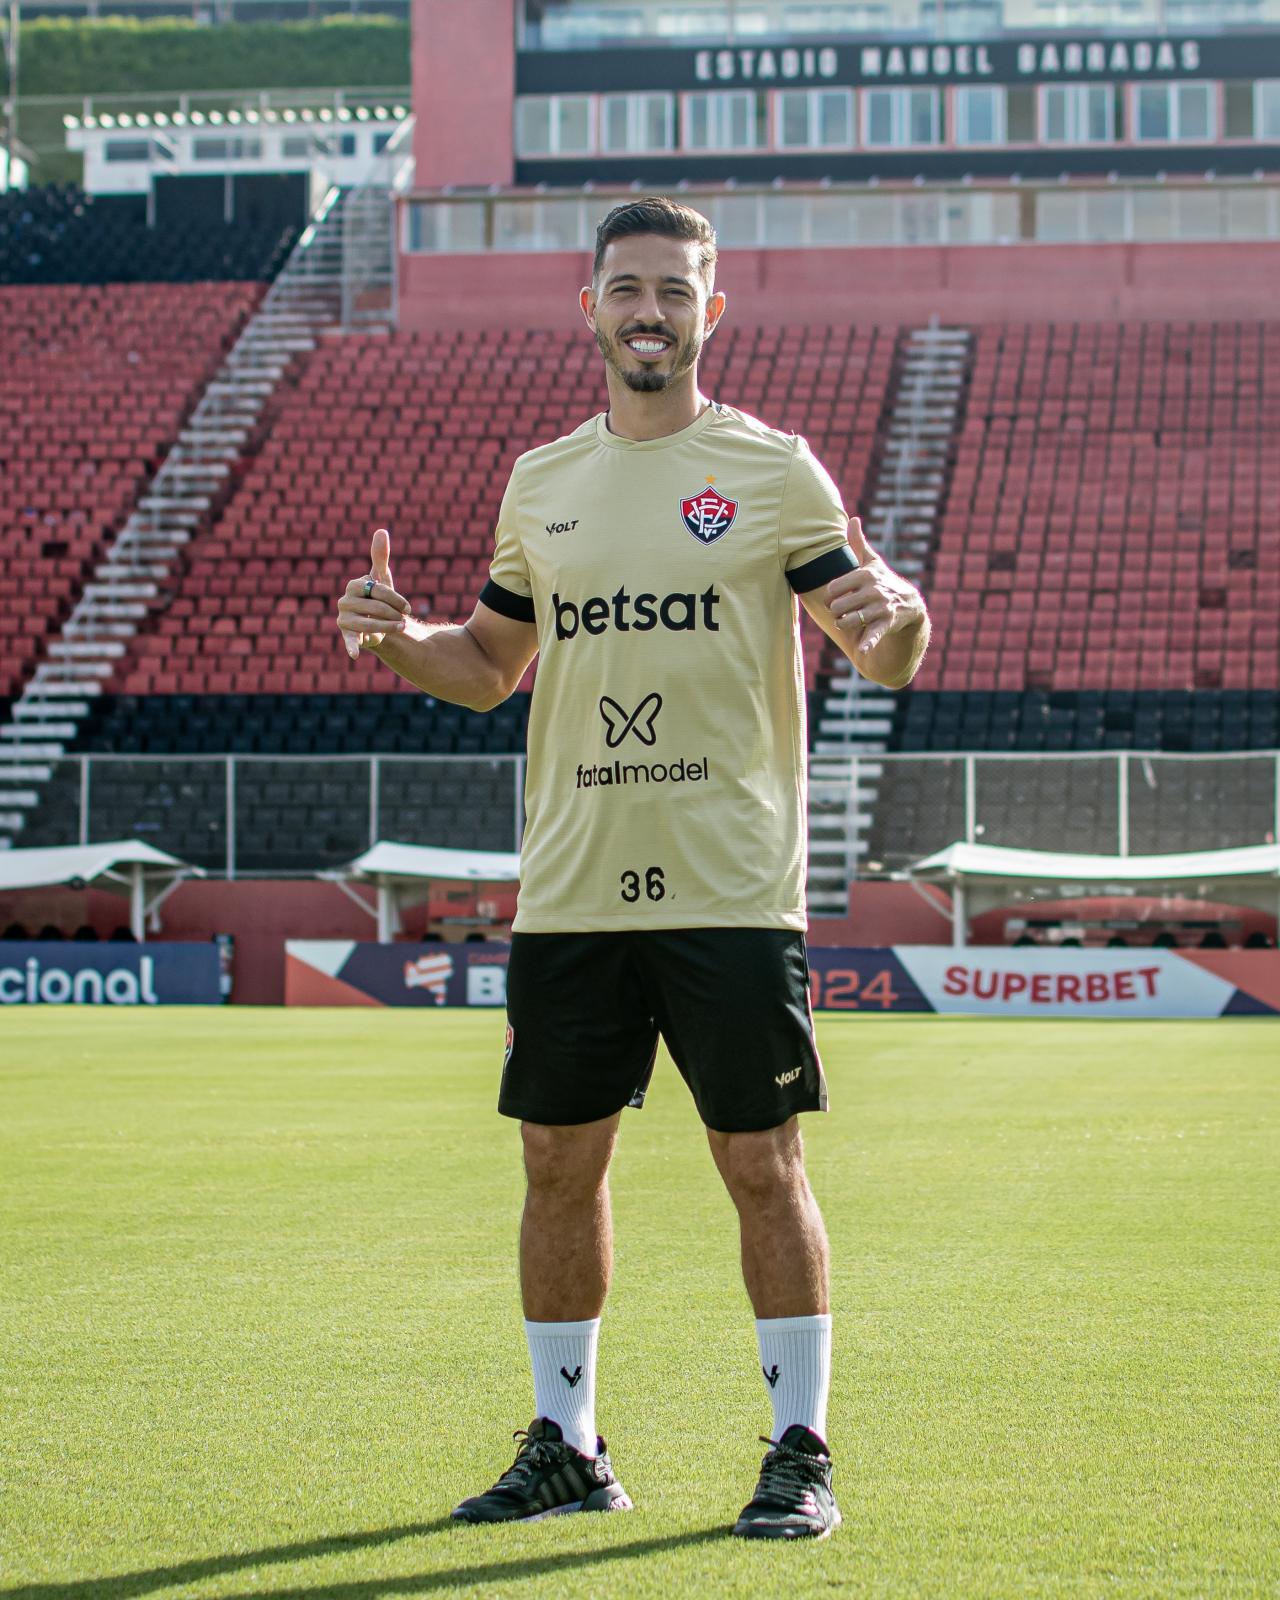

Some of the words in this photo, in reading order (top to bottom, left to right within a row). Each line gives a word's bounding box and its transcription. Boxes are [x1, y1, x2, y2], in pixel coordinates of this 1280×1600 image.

[861, 45, 993, 76] MANOEL
[1017, 40, 1200, 73] BARRADAS
[545, 519, 580, 537] VOLT
[552, 583, 720, 641] betsat
[576, 756, 709, 789] fatalmodel
[620, 866, 666, 902] 36
[0, 955, 159, 1004] cional
[943, 965, 1161, 1004] SUPERBET
[775, 1066, 802, 1089] VOLT
